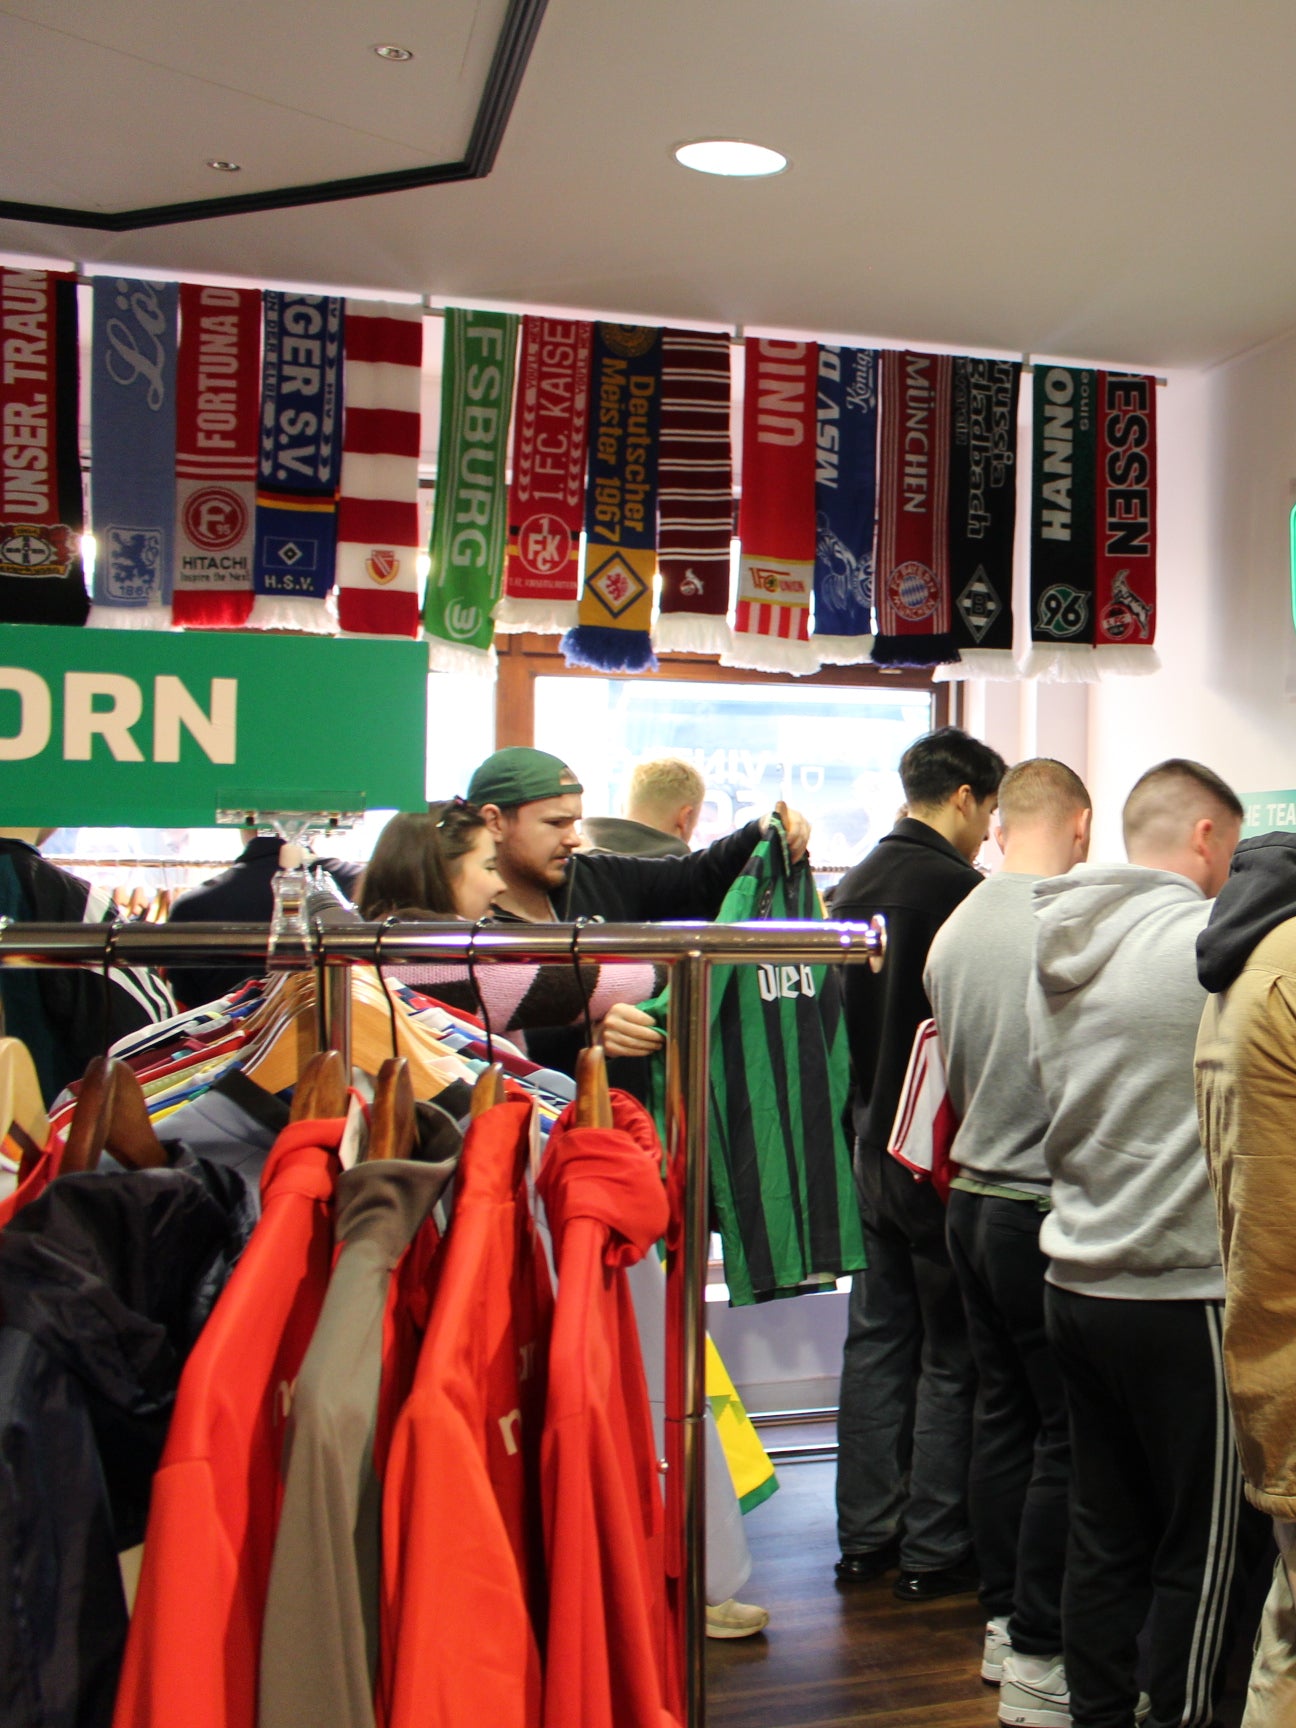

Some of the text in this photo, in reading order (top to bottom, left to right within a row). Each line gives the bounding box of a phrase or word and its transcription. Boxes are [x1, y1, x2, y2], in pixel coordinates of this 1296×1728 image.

[196, 314, 240, 449] FORTUNA
[450, 312, 505, 568] FSBURG
[594, 357, 628, 543] Meister 1967
[624, 375, 655, 532] Deutscher
[814, 391, 841, 489] MSV
[903, 355, 931, 514] MÜNCHEN
[1041, 368, 1075, 542] HANNO
[1105, 371, 1151, 558] ESSEN
[182, 556, 248, 571] HITACHI
[263, 573, 315, 592] H.S.V.
[0, 666, 238, 765] ORN
